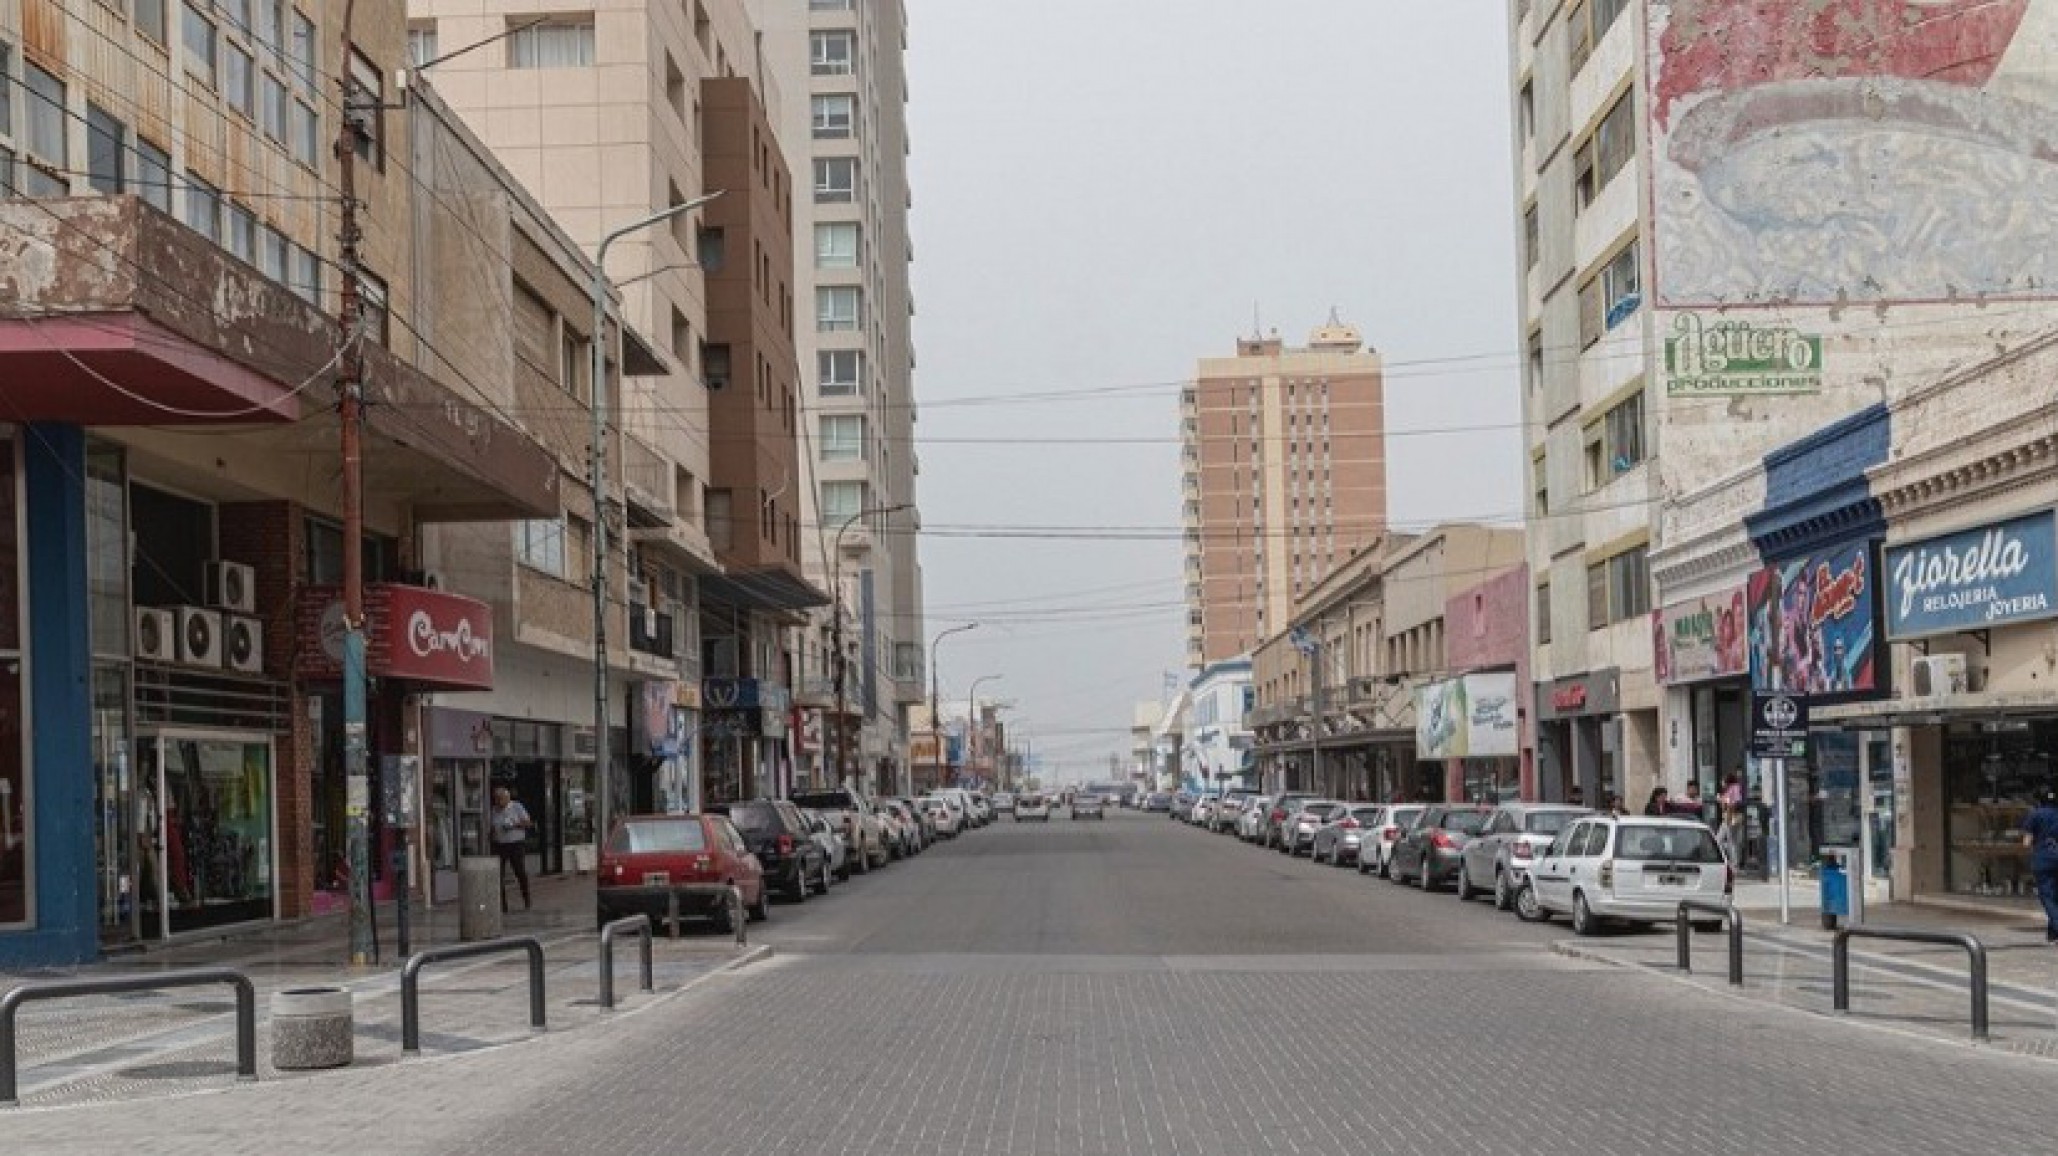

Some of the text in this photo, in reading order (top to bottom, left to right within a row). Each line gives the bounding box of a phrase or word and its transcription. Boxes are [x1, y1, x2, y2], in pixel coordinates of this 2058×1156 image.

[1667, 375, 1822, 393] producciones
[1894, 528, 2029, 622] Fiorella
[1985, 592, 2048, 620] JOYERIA
